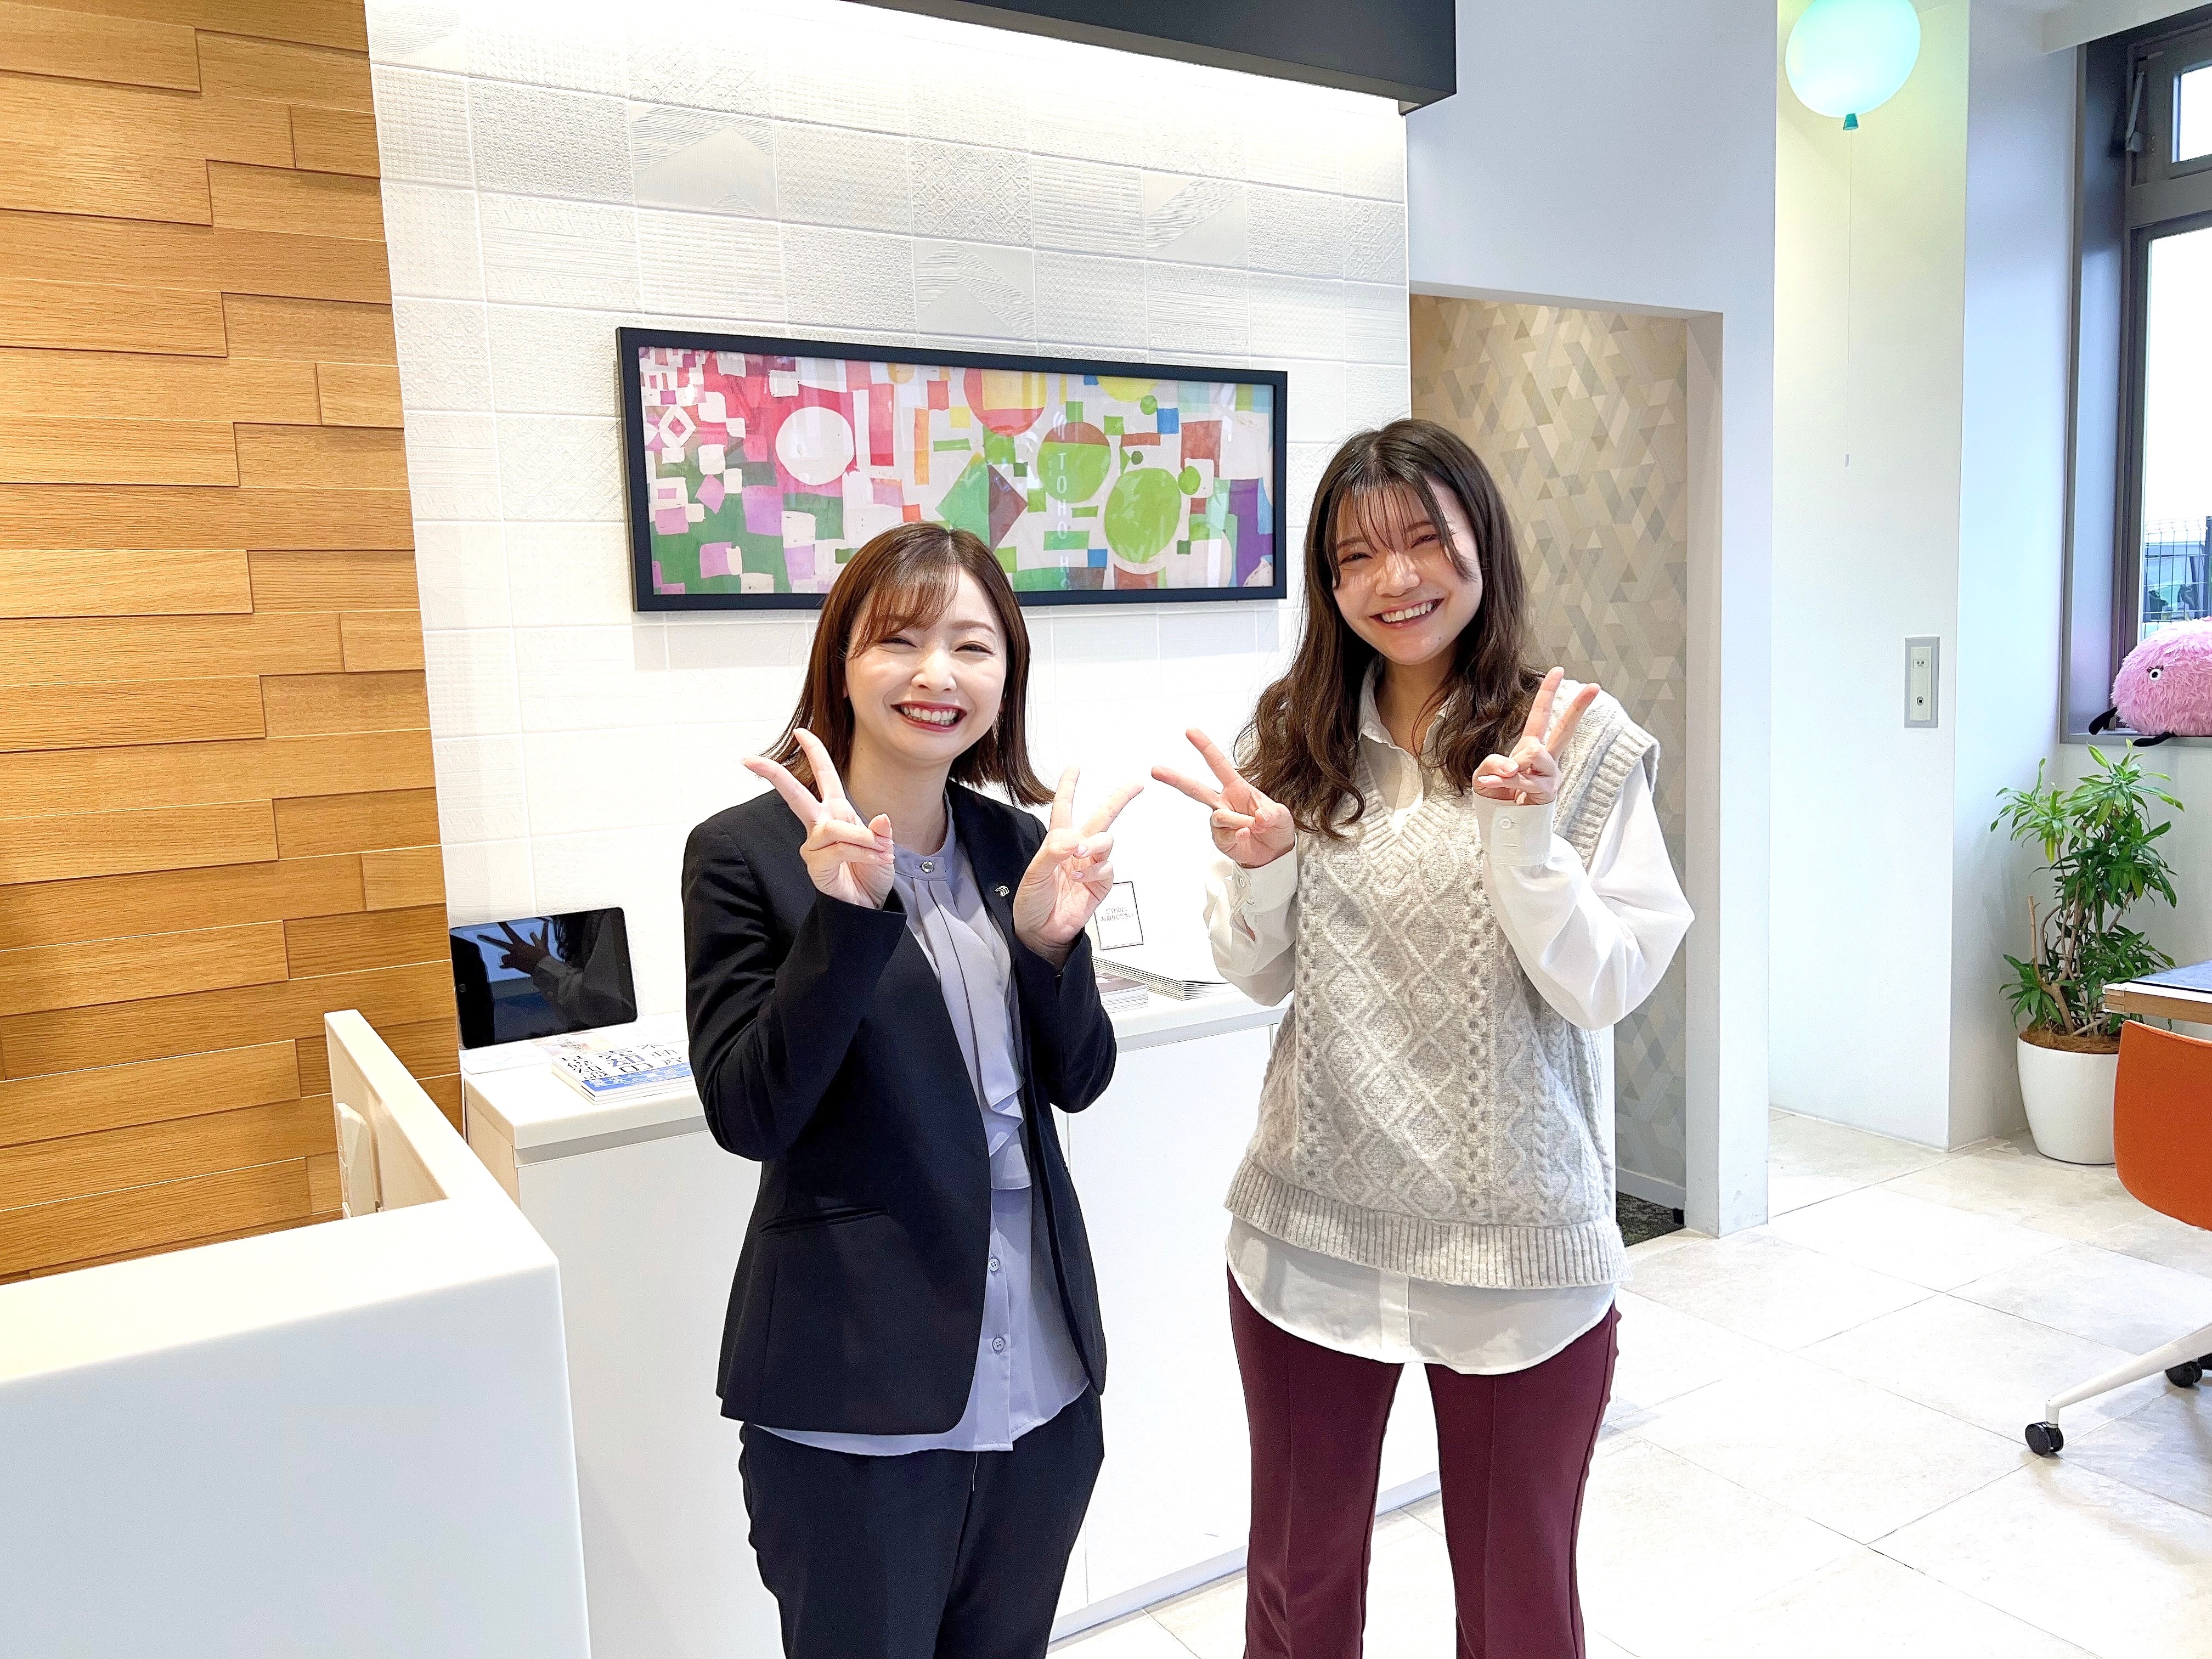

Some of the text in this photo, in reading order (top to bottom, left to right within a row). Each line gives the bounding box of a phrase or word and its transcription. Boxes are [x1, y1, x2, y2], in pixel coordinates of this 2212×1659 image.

[1101, 913, 1134, 922] お取りください
